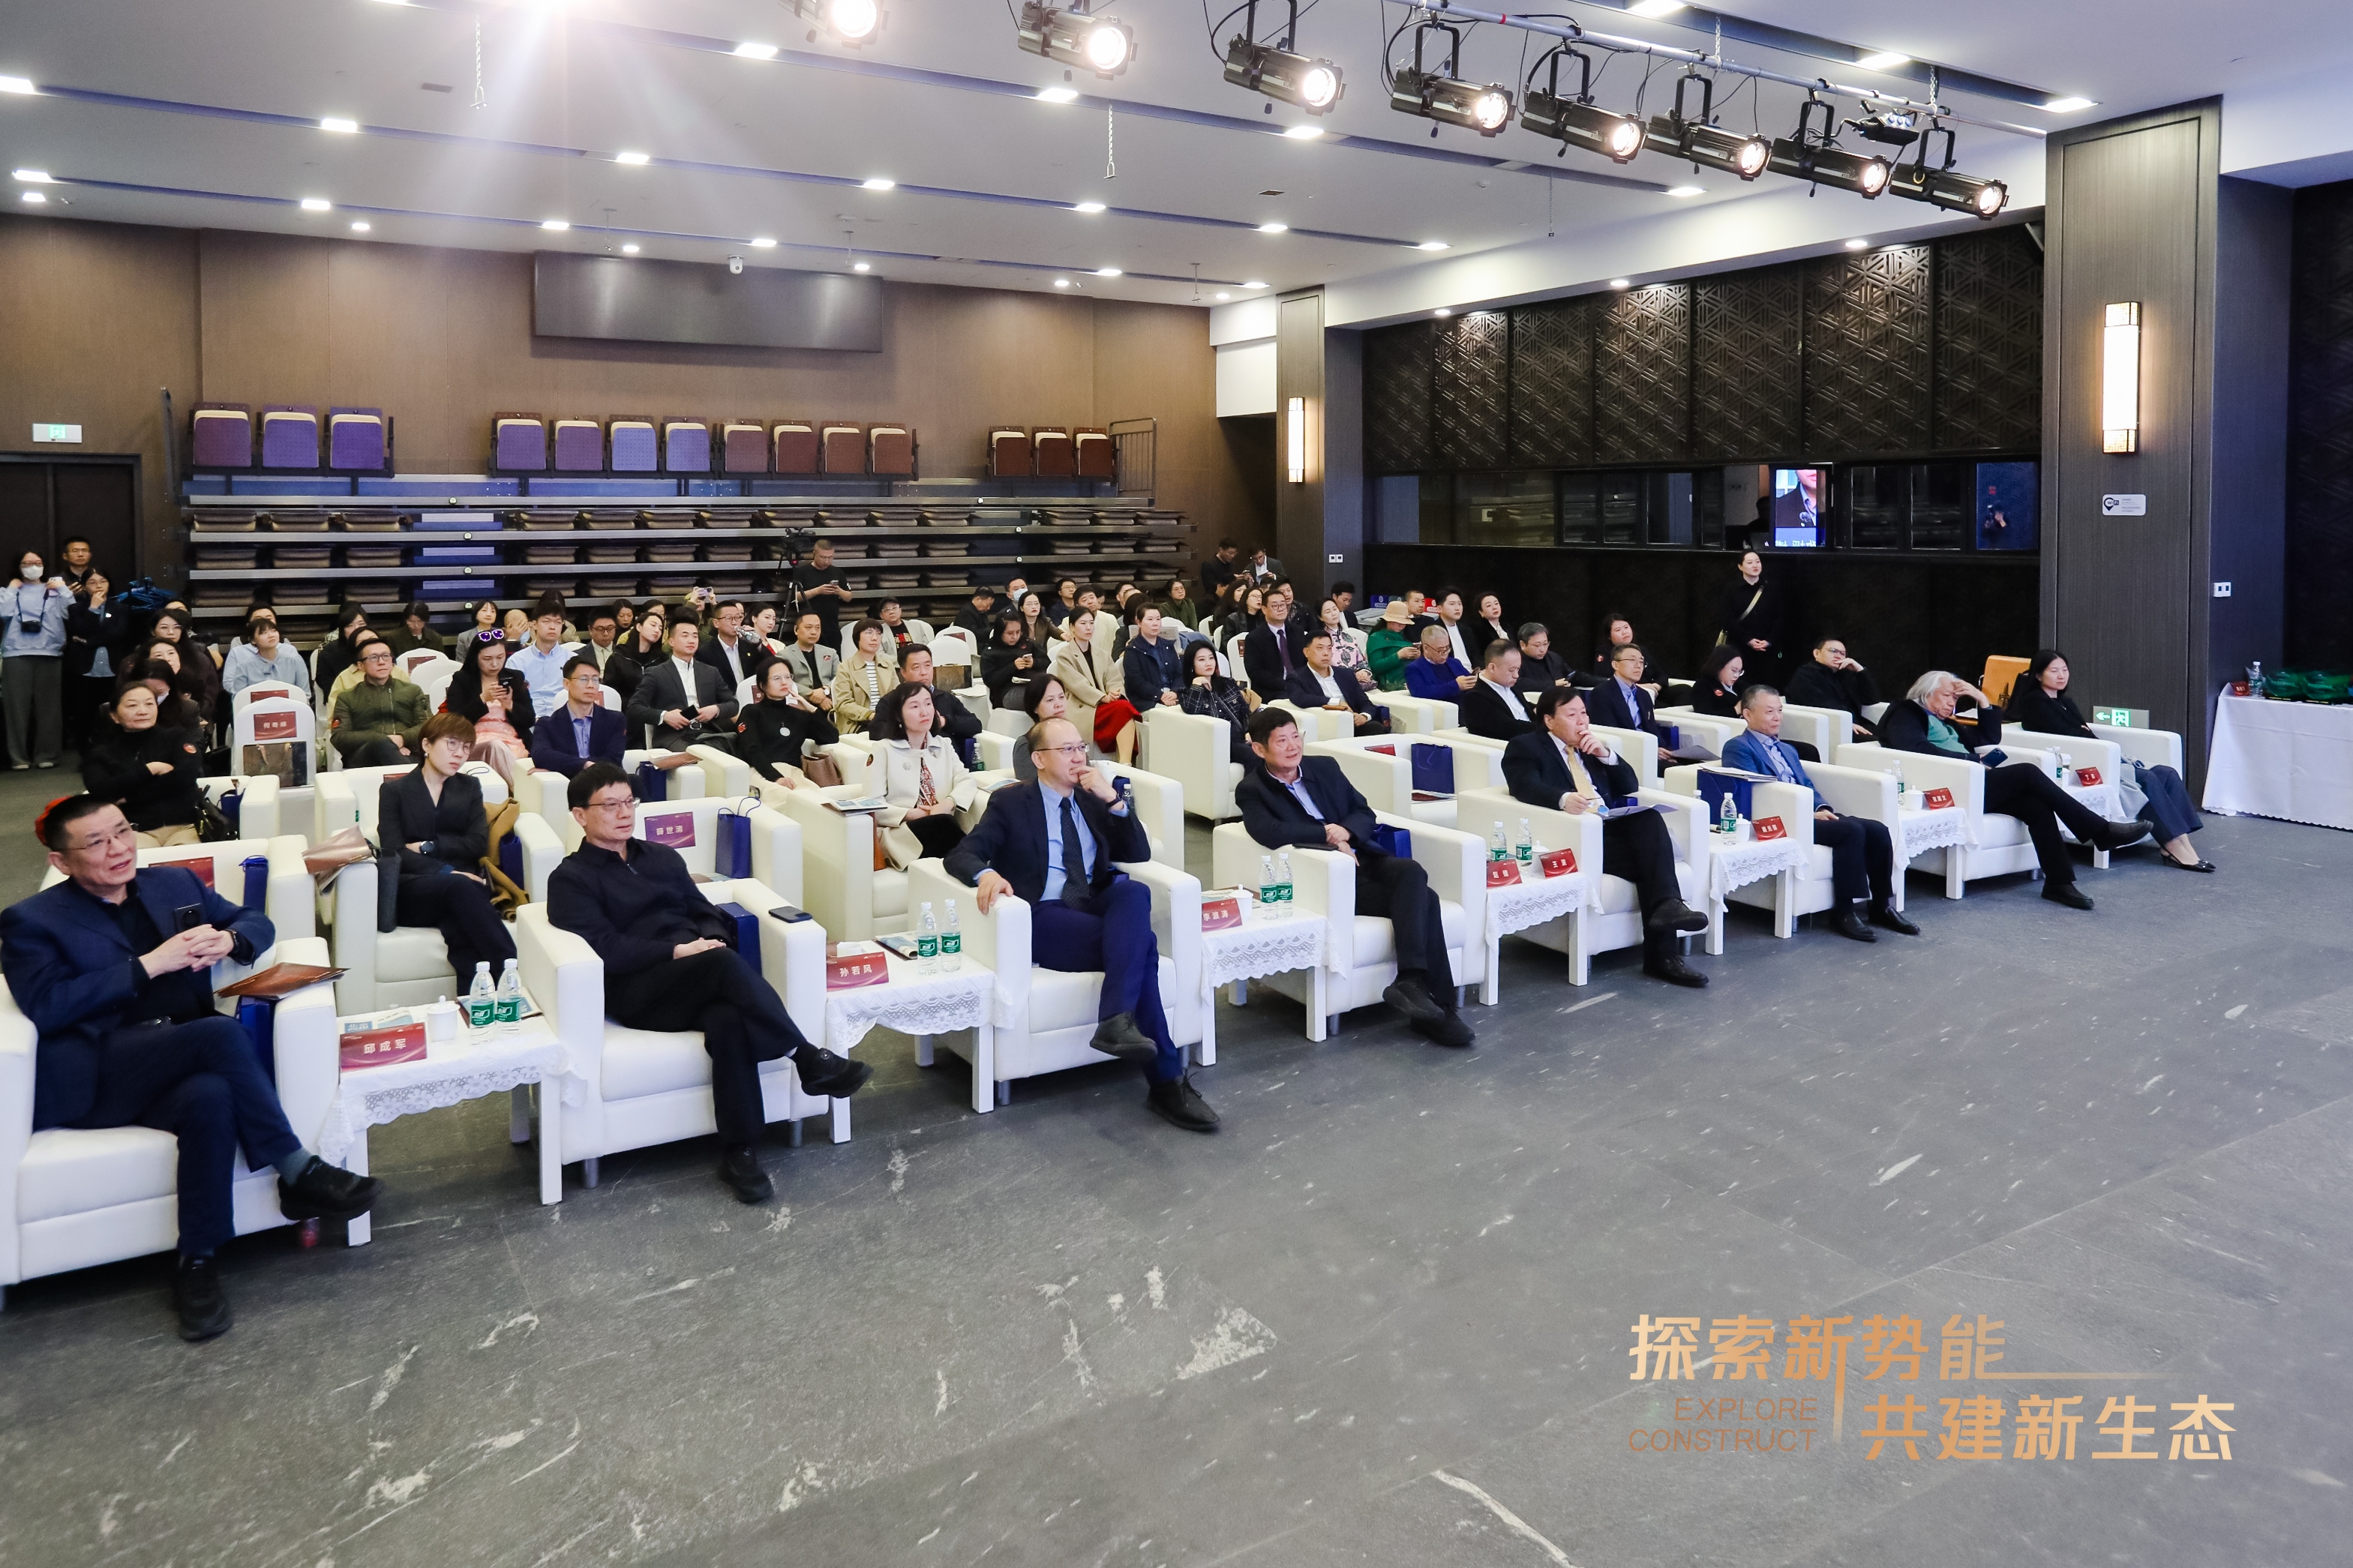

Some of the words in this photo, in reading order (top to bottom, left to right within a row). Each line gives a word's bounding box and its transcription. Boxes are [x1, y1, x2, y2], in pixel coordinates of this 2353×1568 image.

[839, 964, 872, 977] 孙若风
[364, 1038, 407, 1054] 邱成军
